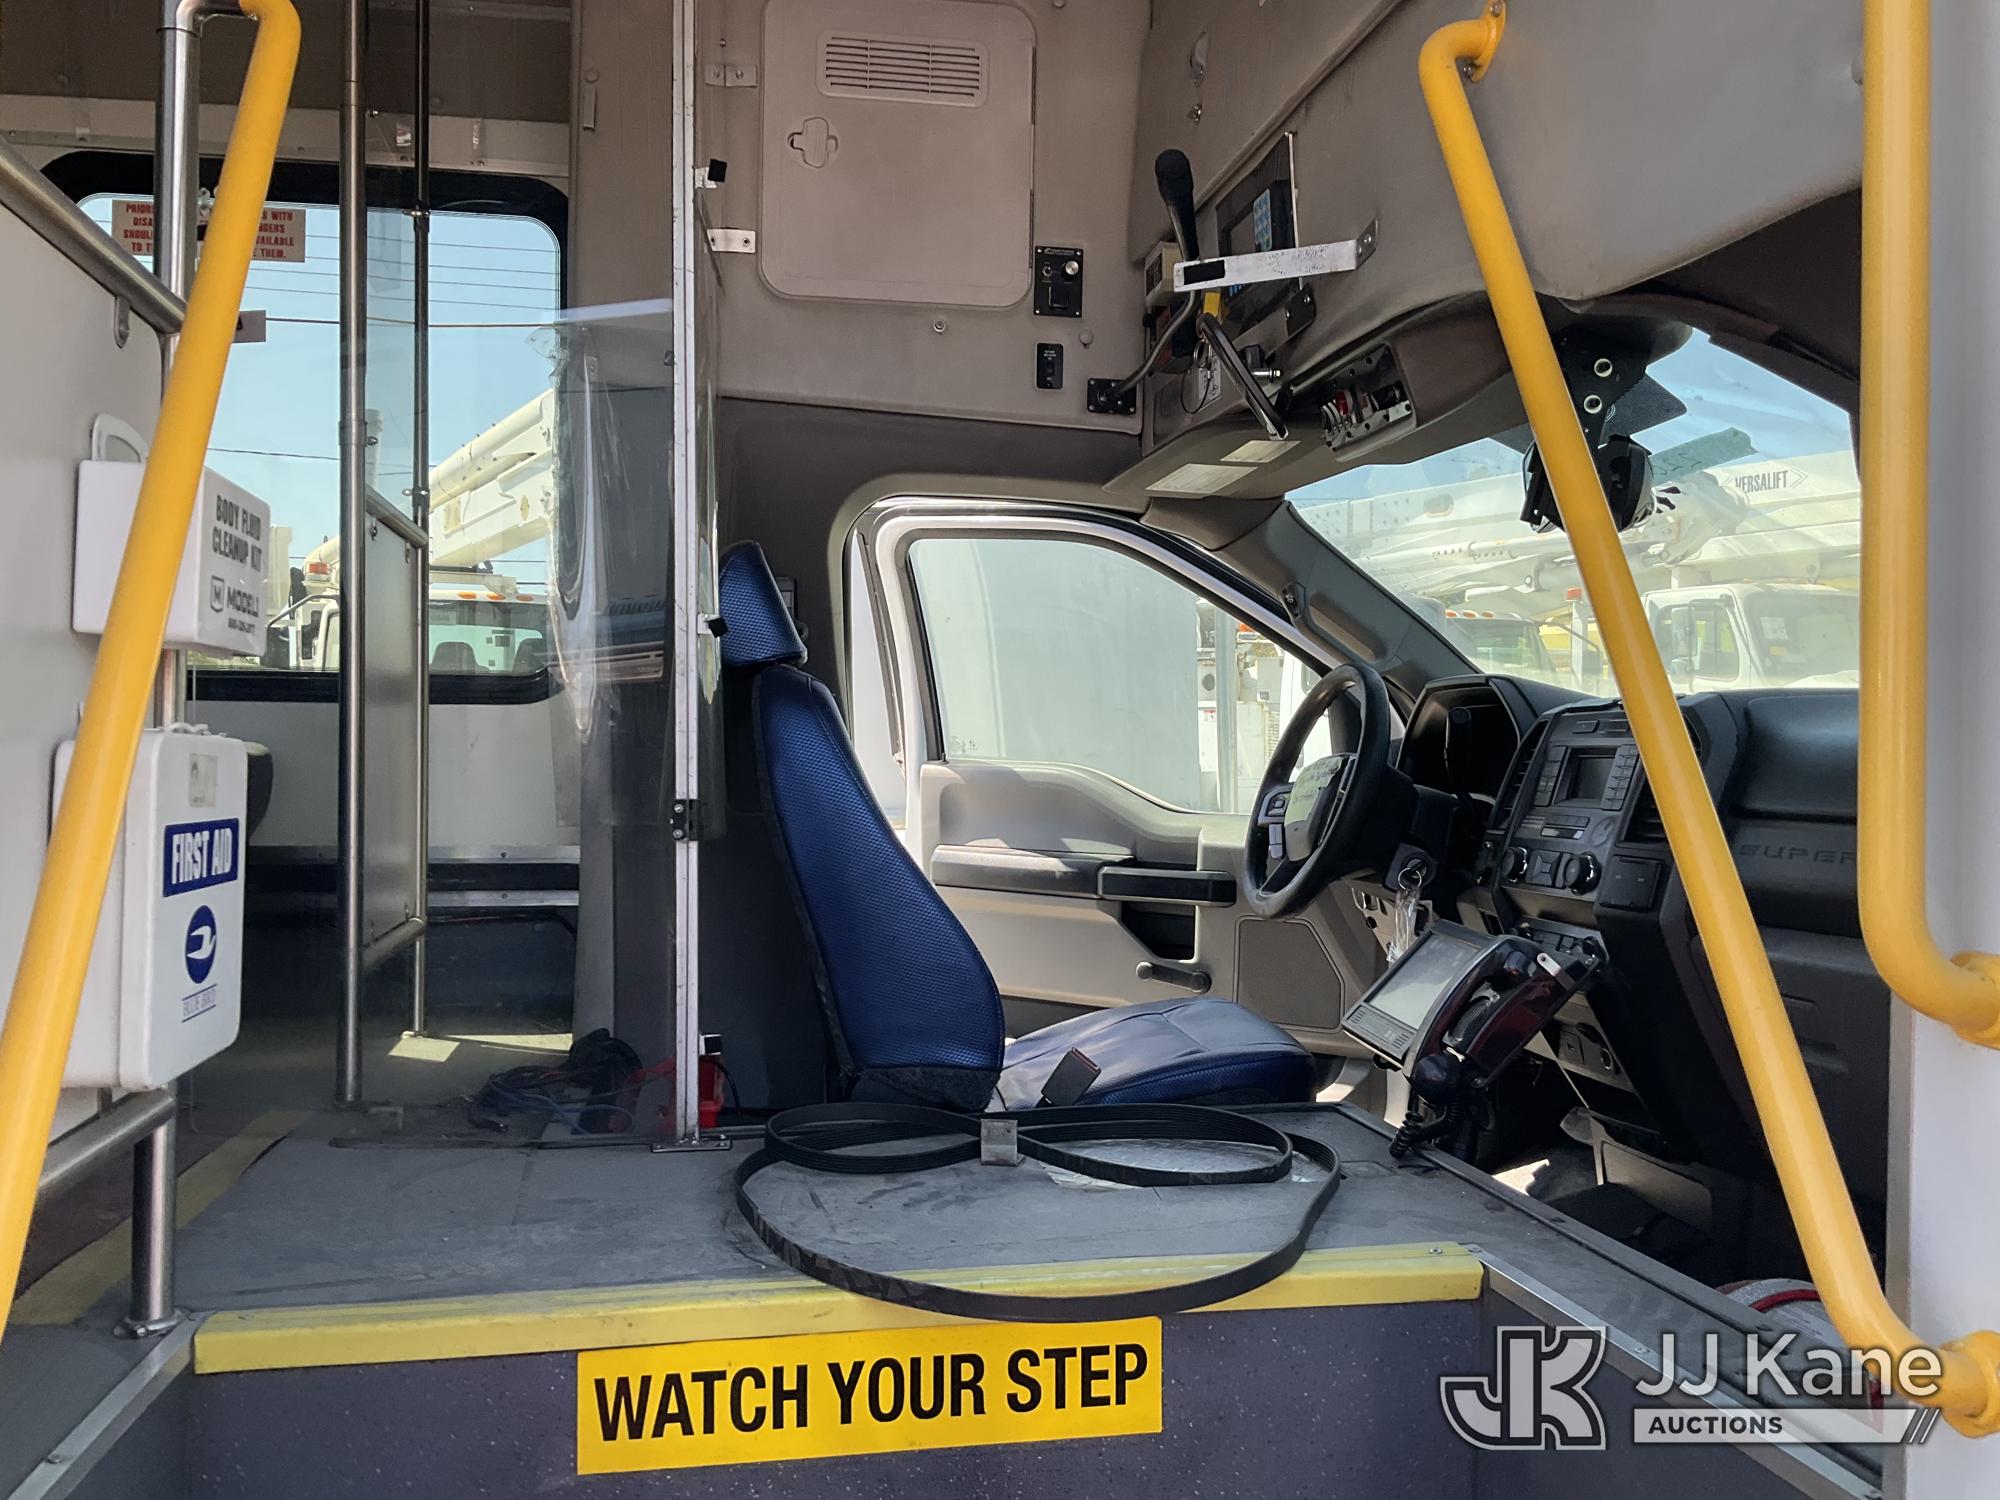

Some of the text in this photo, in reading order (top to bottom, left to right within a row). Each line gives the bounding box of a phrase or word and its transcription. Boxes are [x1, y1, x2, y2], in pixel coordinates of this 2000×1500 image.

[271, 211, 293, 221] WITH
[123, 229, 294, 247] SHOUL VAILABLE
[131, 242, 143, 252] TO
[1735, 470, 1788, 493] VERSALIFT
[216, 494, 261, 542] BODY FLUID
[212, 525, 262, 573] CLEANUP KIT
[171, 828, 233, 885] FIRST AID
[593, 1342, 1148, 1442] WATCH YOUR STEP
